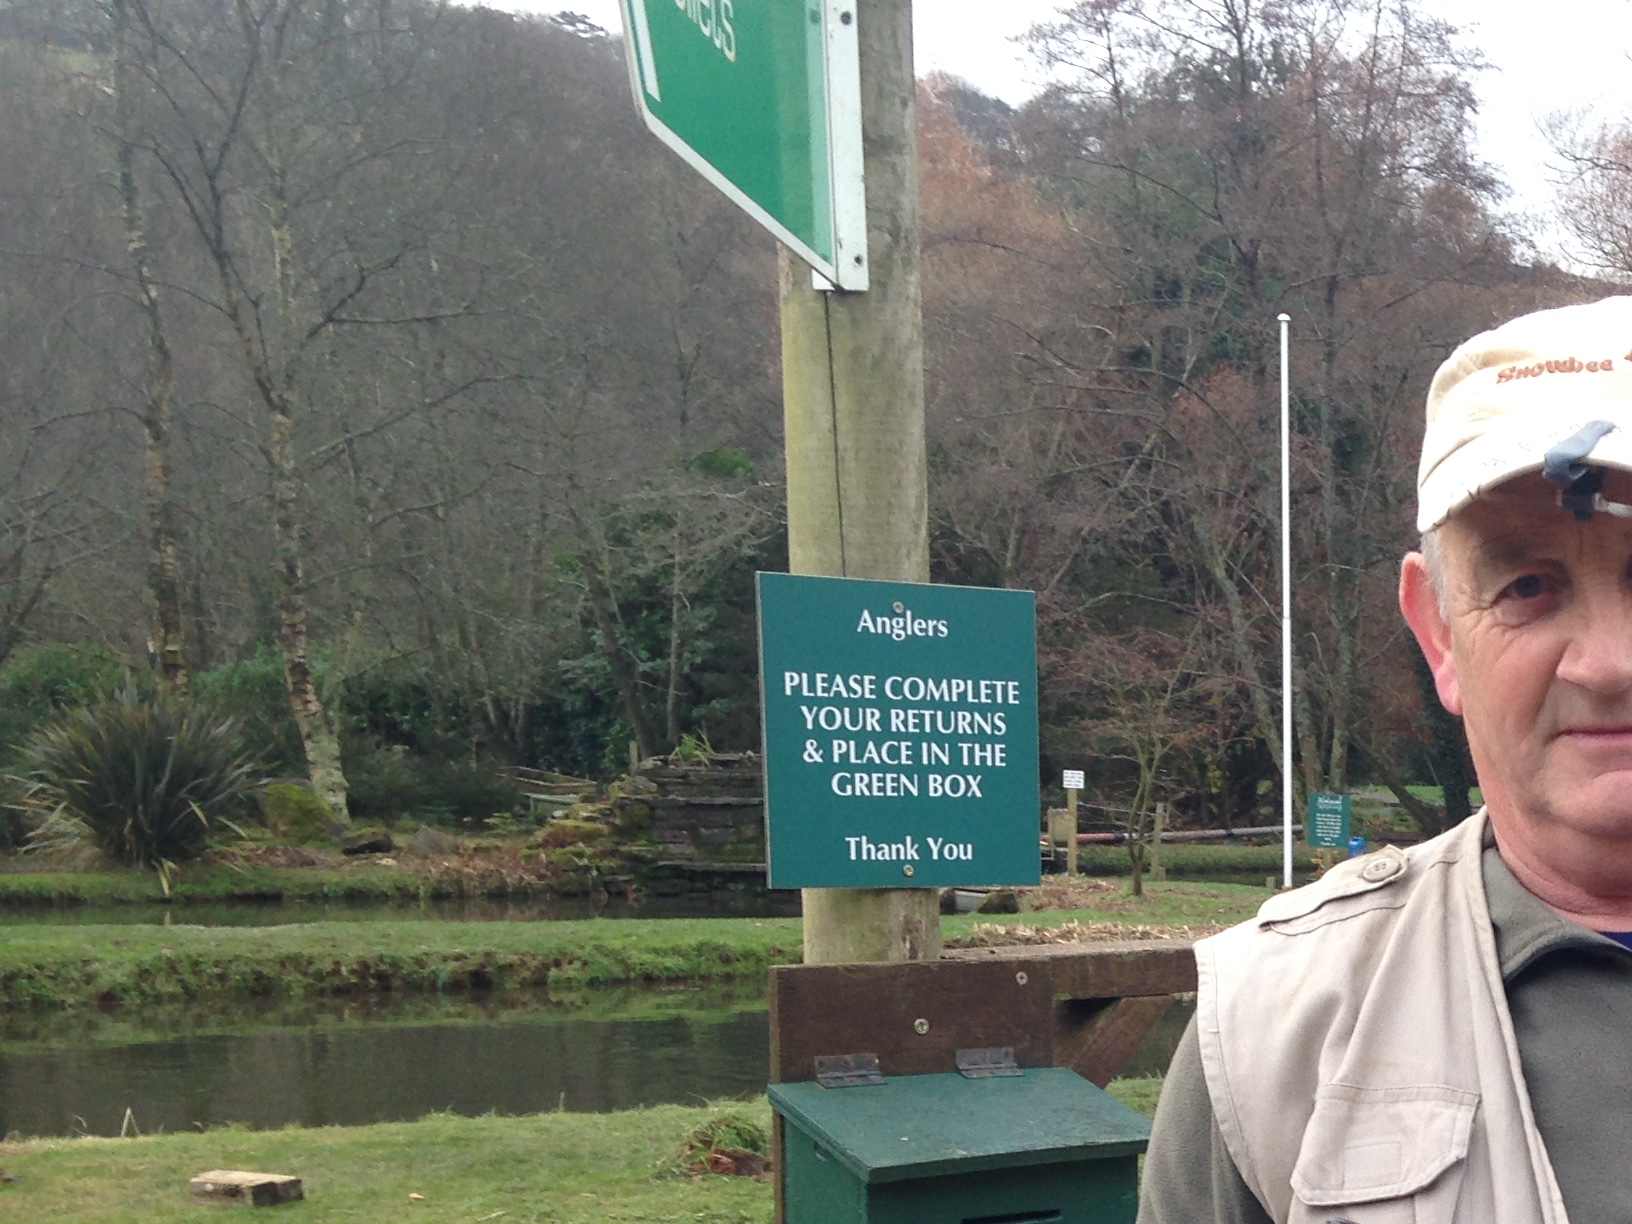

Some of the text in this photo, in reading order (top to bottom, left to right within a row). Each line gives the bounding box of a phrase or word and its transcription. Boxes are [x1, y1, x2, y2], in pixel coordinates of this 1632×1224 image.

[856, 609, 948, 641] Anglers
[784, 671, 1020, 704] PLEASE COMPLETE
[800, 705, 1007, 735] YOUR RETURNS
[802, 739, 1007, 767] & PLACE IN THE
[830, 772, 983, 797] GREEN BOX
[845, 835, 973, 861] Thank You
